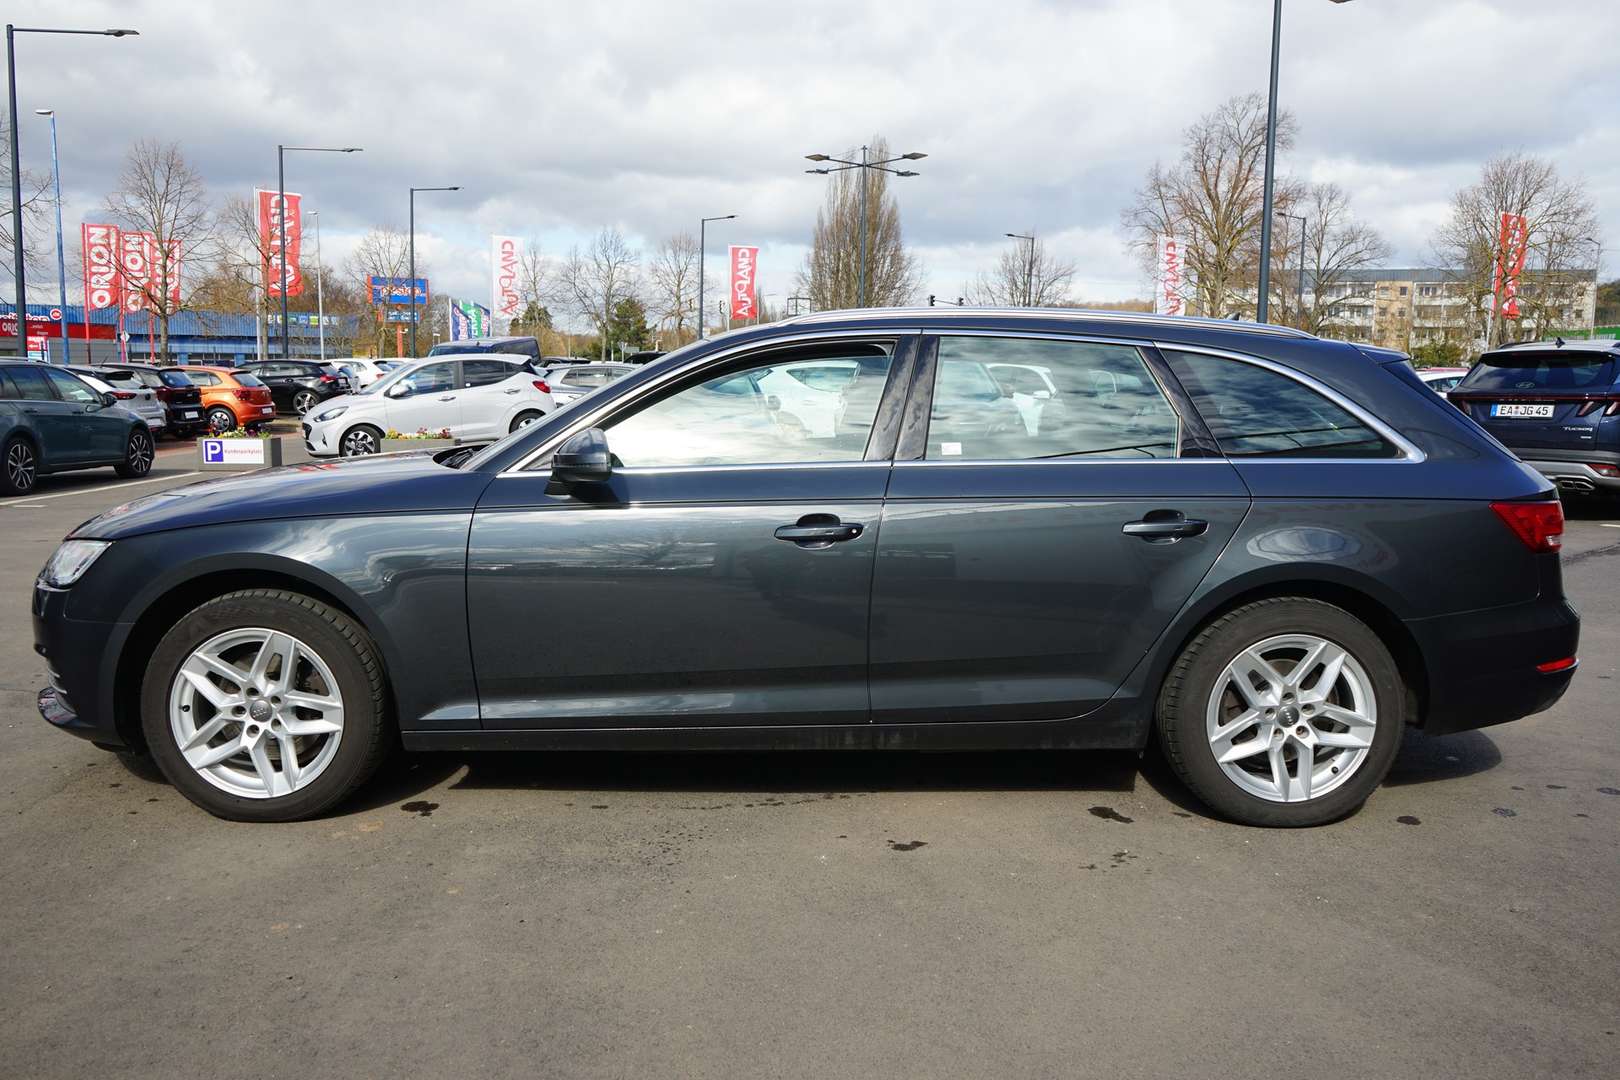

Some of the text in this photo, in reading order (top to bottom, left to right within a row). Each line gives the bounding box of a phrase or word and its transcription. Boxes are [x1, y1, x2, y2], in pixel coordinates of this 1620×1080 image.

[89, 227, 116, 309] ORION
[499, 240, 519, 316] AUTOLAND
[735, 248, 753, 316] AUTOLAND
[1500, 406, 1549, 416] EA JG 45
[206, 441, 222, 461] P
